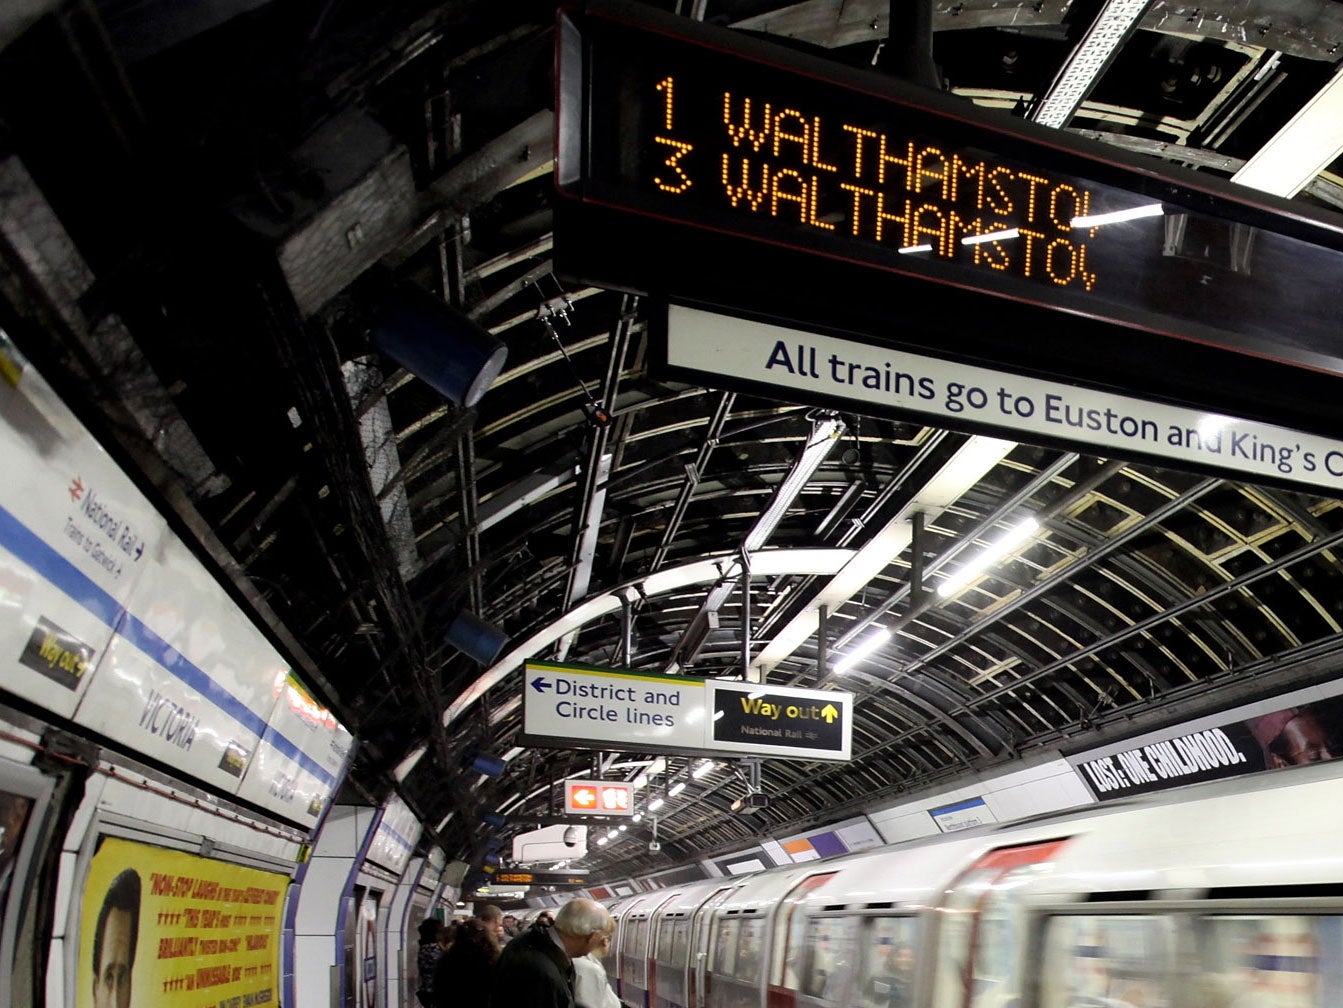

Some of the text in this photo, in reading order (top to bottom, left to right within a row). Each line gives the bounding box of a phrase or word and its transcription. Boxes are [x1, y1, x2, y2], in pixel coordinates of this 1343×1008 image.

[655, 76, 674, 130] 1
[654, 135, 694, 194] 3
[764, 339, 820, 380] All
[828, 353, 937, 402] trains
[944, 380, 989, 414] go
[996, 385, 1036, 419] to
[1043, 393, 1160, 444] Euston
[1167, 416, 1224, 455] and
[1229, 433, 1318, 476] King's
[81, 488, 123, 542] National
[39, 636, 79, 671] Way out
[139, 688, 200, 752] VICTORIA
[555, 678, 682, 708] District and
[556, 700, 675, 728] Circle lines
[741, 697, 820, 721] Way out
[741, 725, 804, 740] National Rail
[1083, 728, 1248, 793] LOST: ONE CHILDHOOD.
